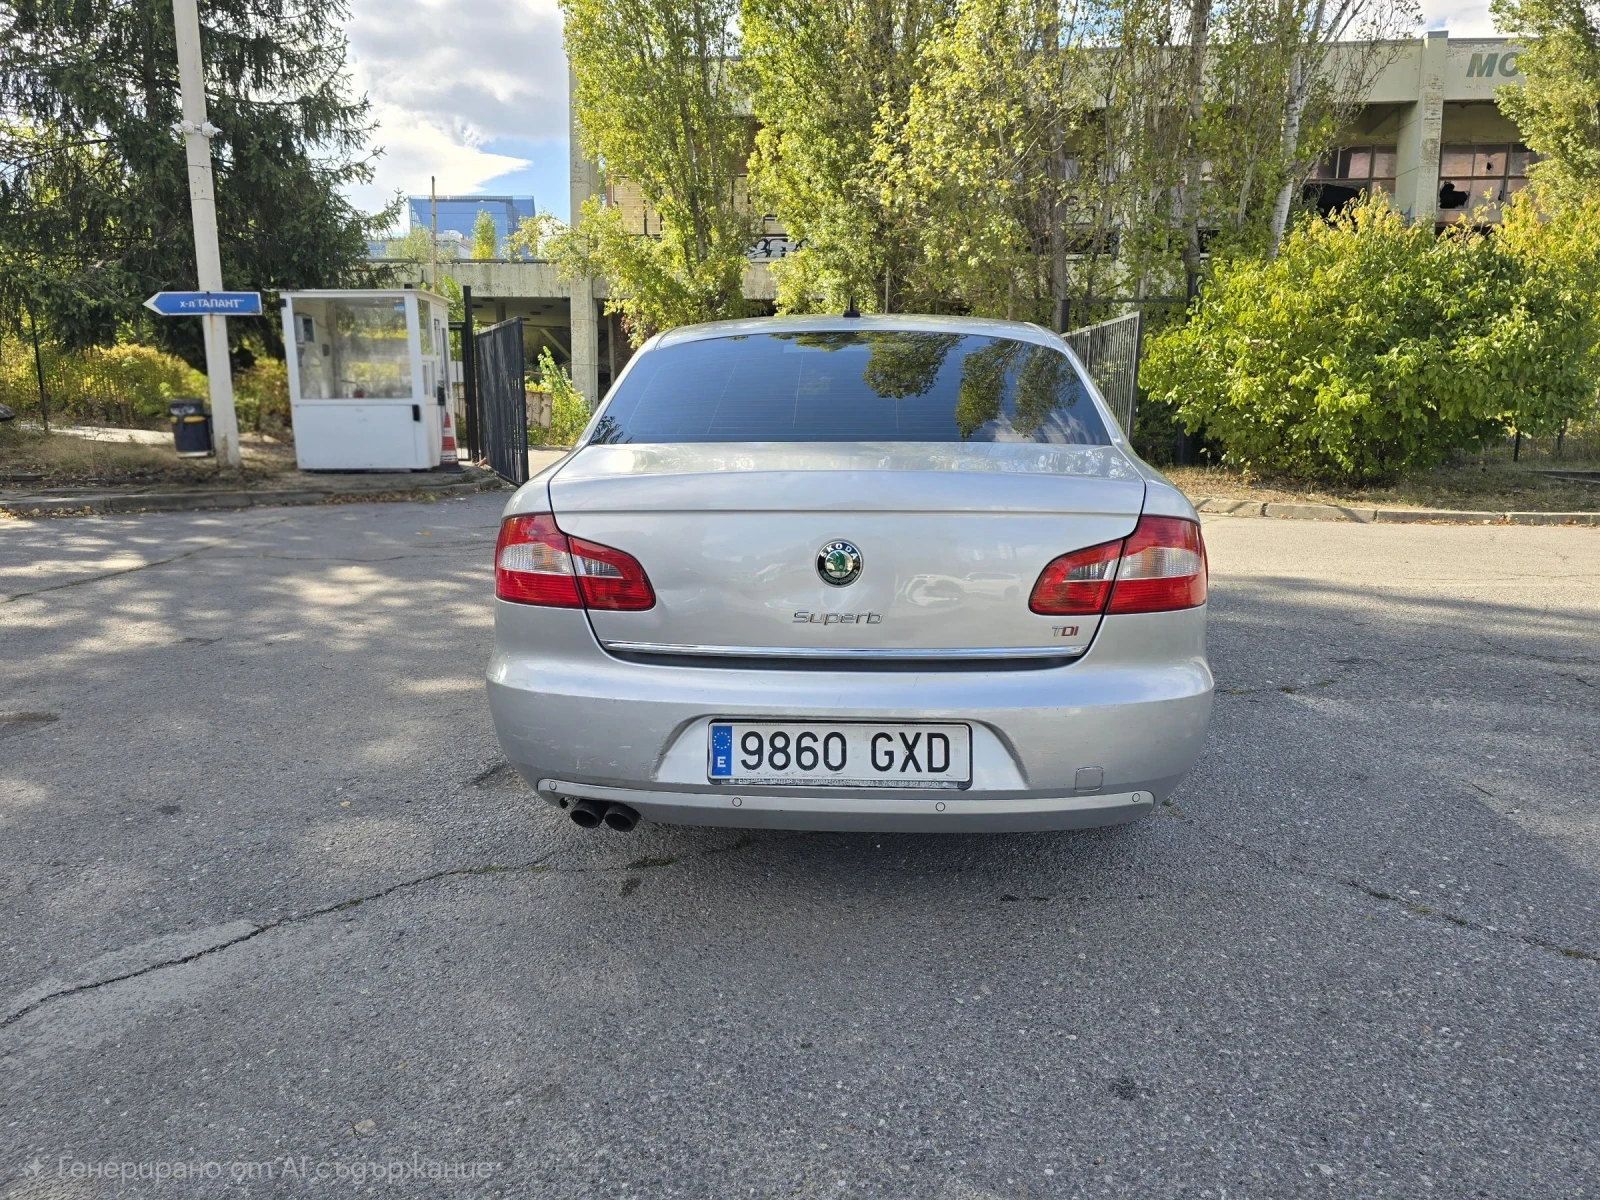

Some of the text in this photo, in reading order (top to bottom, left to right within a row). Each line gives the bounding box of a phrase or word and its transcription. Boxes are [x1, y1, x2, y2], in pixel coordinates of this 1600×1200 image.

[792, 610, 883, 626] Superb
[1052, 625, 1079, 637] TDI
[740, 730, 950, 773] 9860 GXD
[717, 756, 727, 768] E
